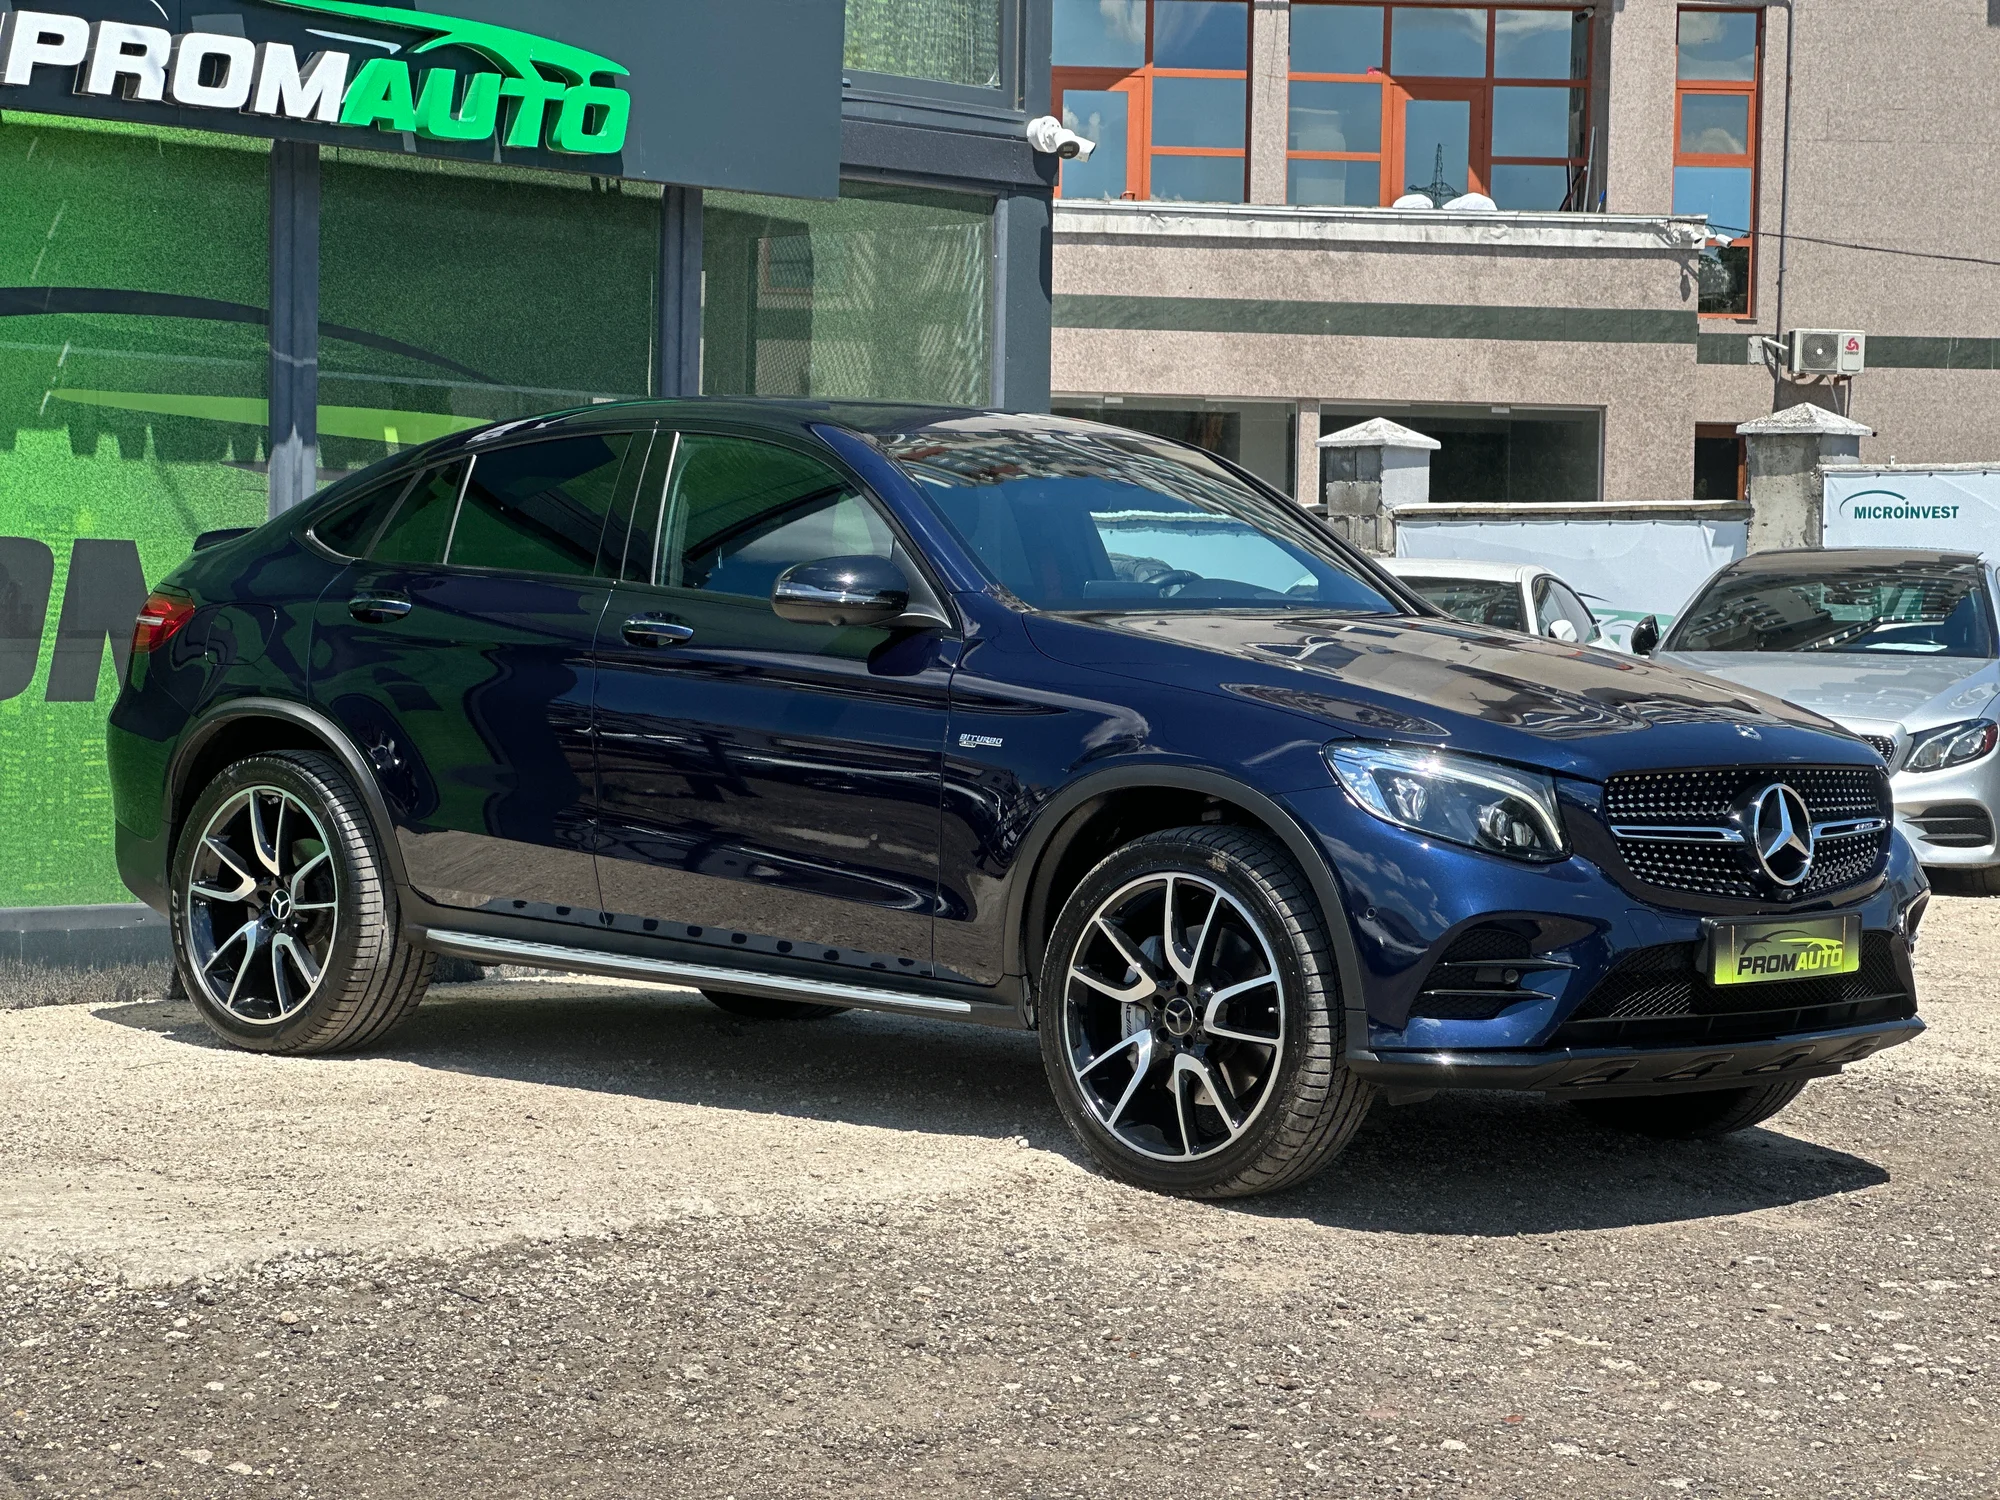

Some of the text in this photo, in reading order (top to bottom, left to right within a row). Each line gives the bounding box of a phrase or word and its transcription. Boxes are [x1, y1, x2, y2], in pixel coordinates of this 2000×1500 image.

[4, 10, 631, 154] PROMAUTO
[960, 733, 1003, 744] BITURBO
[1737, 948, 1843, 975] PROMAUTO
